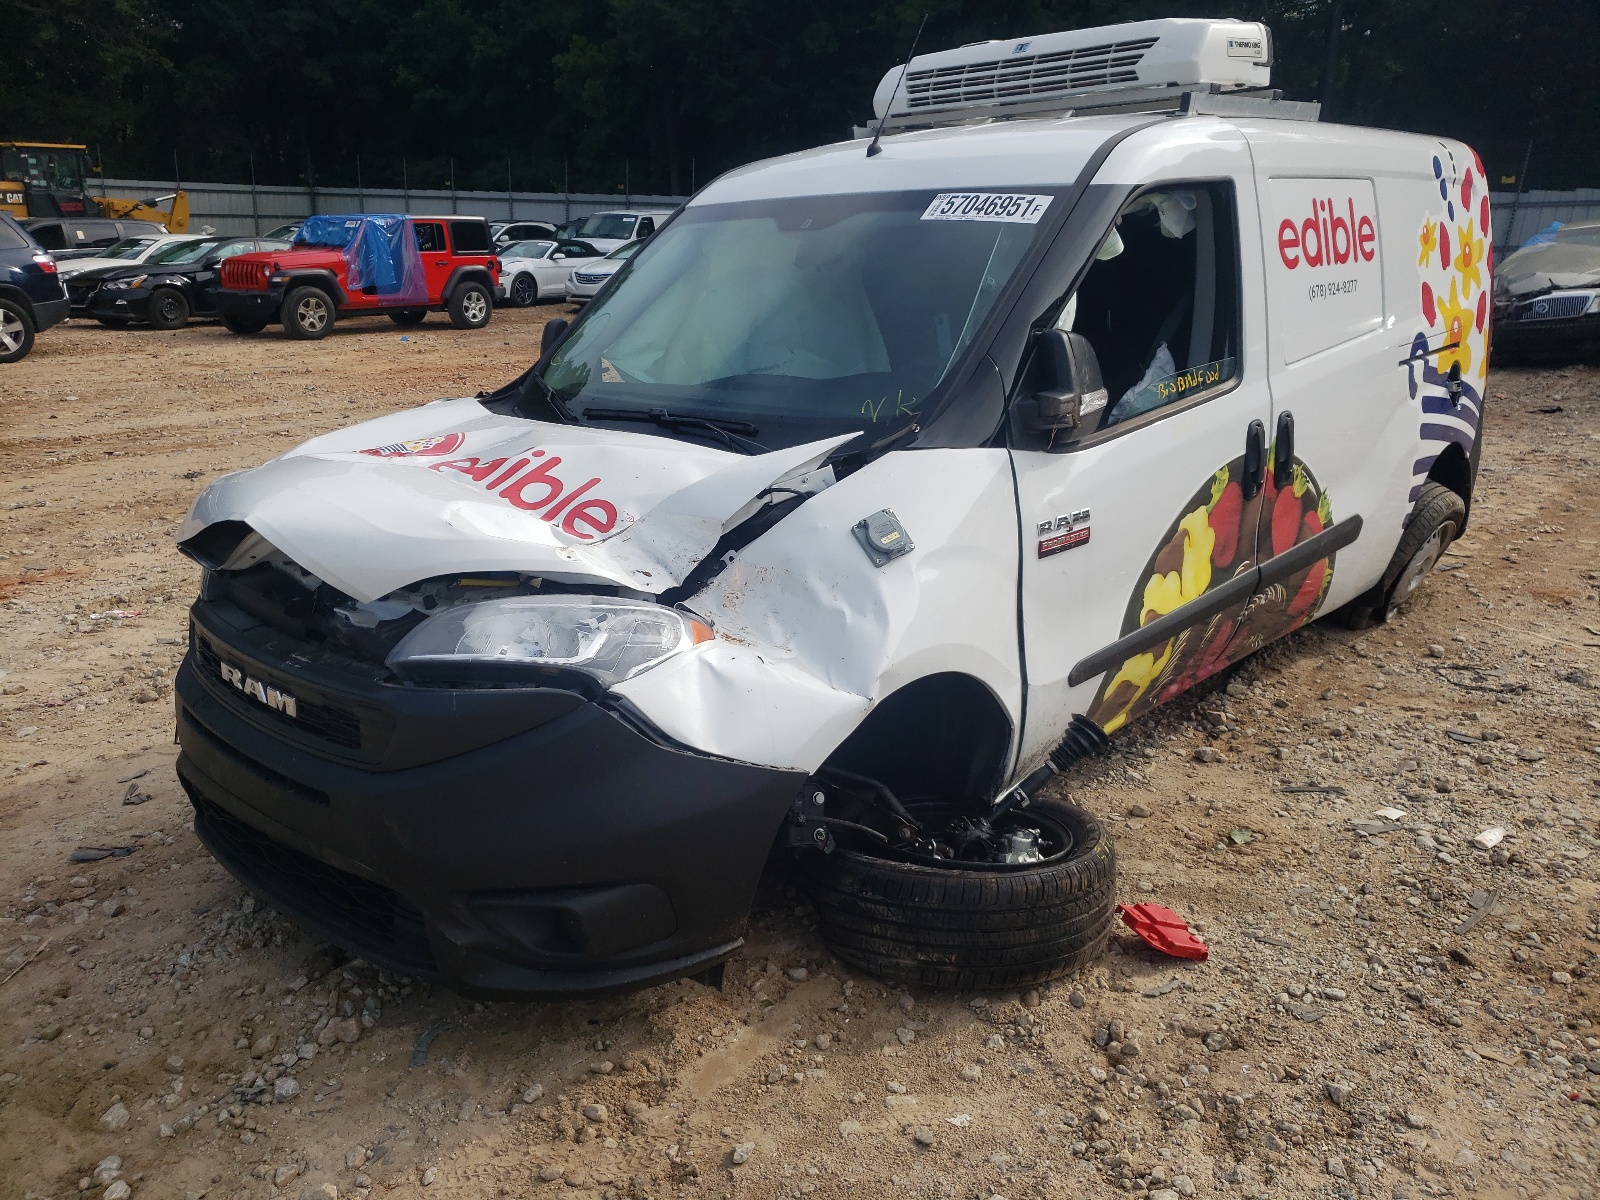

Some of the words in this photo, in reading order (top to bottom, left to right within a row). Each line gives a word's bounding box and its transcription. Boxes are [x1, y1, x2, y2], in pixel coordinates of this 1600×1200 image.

[6, 193, 24, 204] CAT
[940, 194, 1036, 218] 57046951
[1030, 204, 1043, 216] F
[1278, 196, 1376, 270] edible
[1308, 284, 1328, 302] (678)
[1327, 279, 1358, 296] 924-8277
[1037, 507, 1091, 537] RAM
[220, 661, 297, 718] RAM
